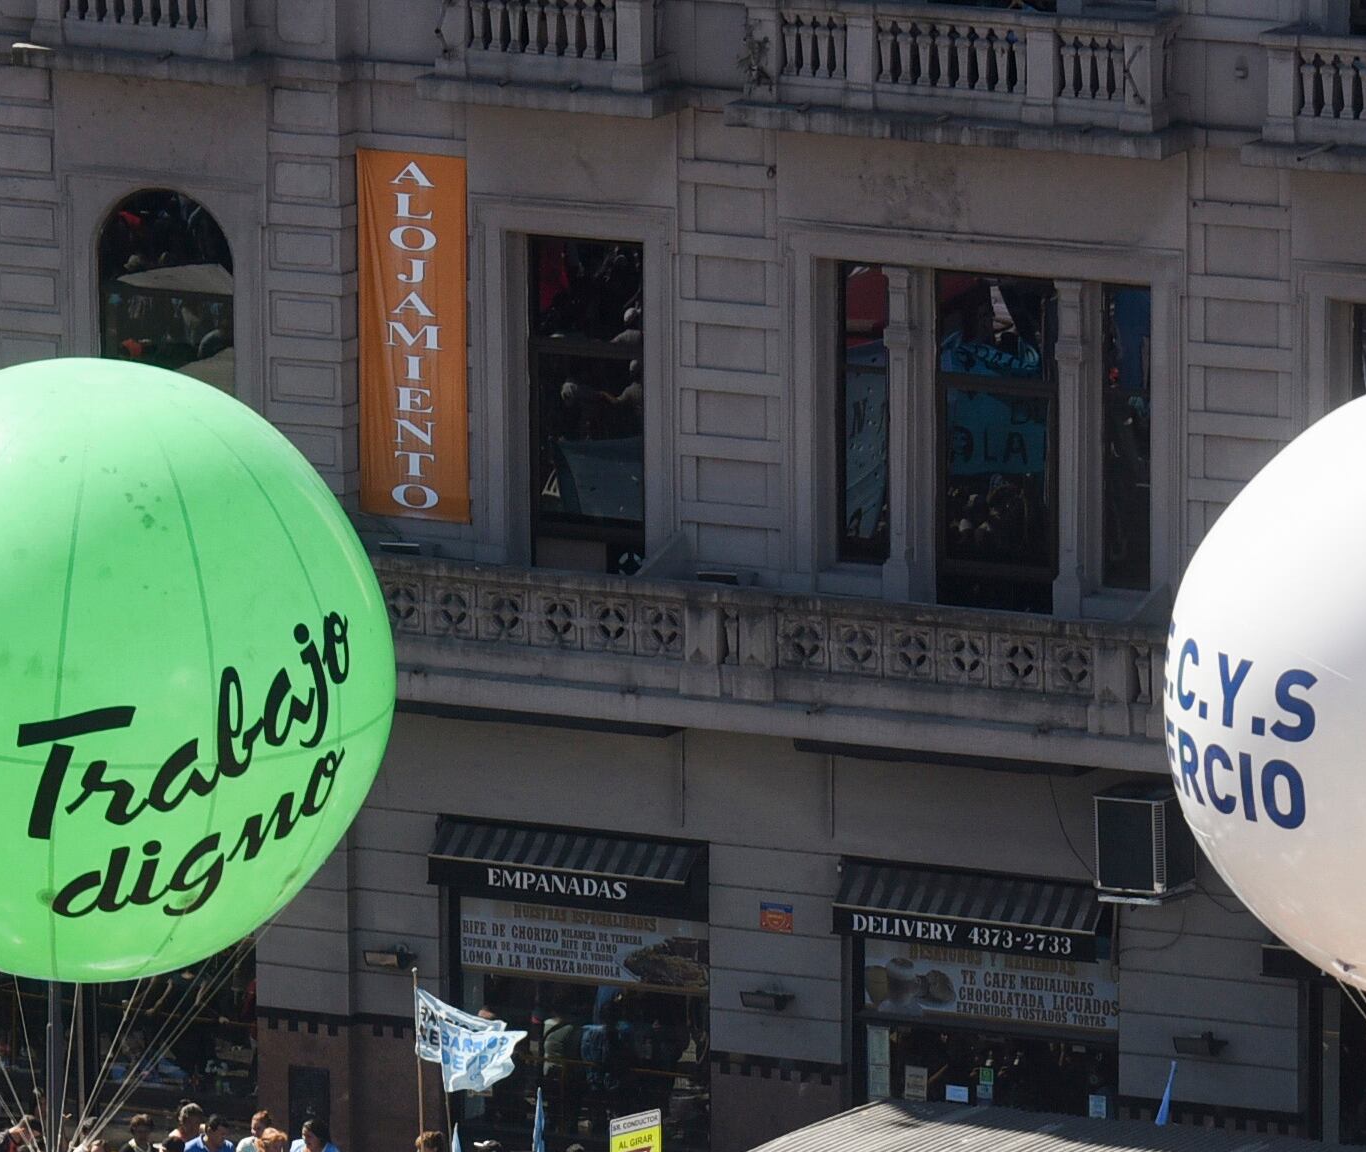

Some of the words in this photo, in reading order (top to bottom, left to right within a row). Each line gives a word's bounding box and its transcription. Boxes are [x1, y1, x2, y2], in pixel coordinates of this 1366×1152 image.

[384, 160, 443, 511] ALOJAMIENTO
[18, 609, 351, 841] Trabajo
[52, 745, 346, 919] digno
[486, 865, 629, 902] EMPANADAS
[492, 923, 506, 937] DE
[512, 924, 558, 943] CHORIZO
[851, 912, 958, 945] DELIVERY
[967, 922, 1074, 956] 4373-2733
[462, 950, 492, 965] LOMO
[527, 957, 575, 973] MOSTAZA
[596, 943, 618, 954] LOMO
[960, 969, 976, 985] TE
[983, 972, 1016, 990] CAFE
[1020, 977, 1095, 996] MEDIALUNAS
[958, 987, 1044, 1008] CHOCOLATADA
[1053, 996, 1121, 1017] LICUADOS
[1017, 1008, 1068, 1023] TOSTADOS
[623, 1114, 658, 1129] CONDUCTOR
[618, 1141, 628, 1149] AL
[630, 1134, 653, 1148] GIRAR
